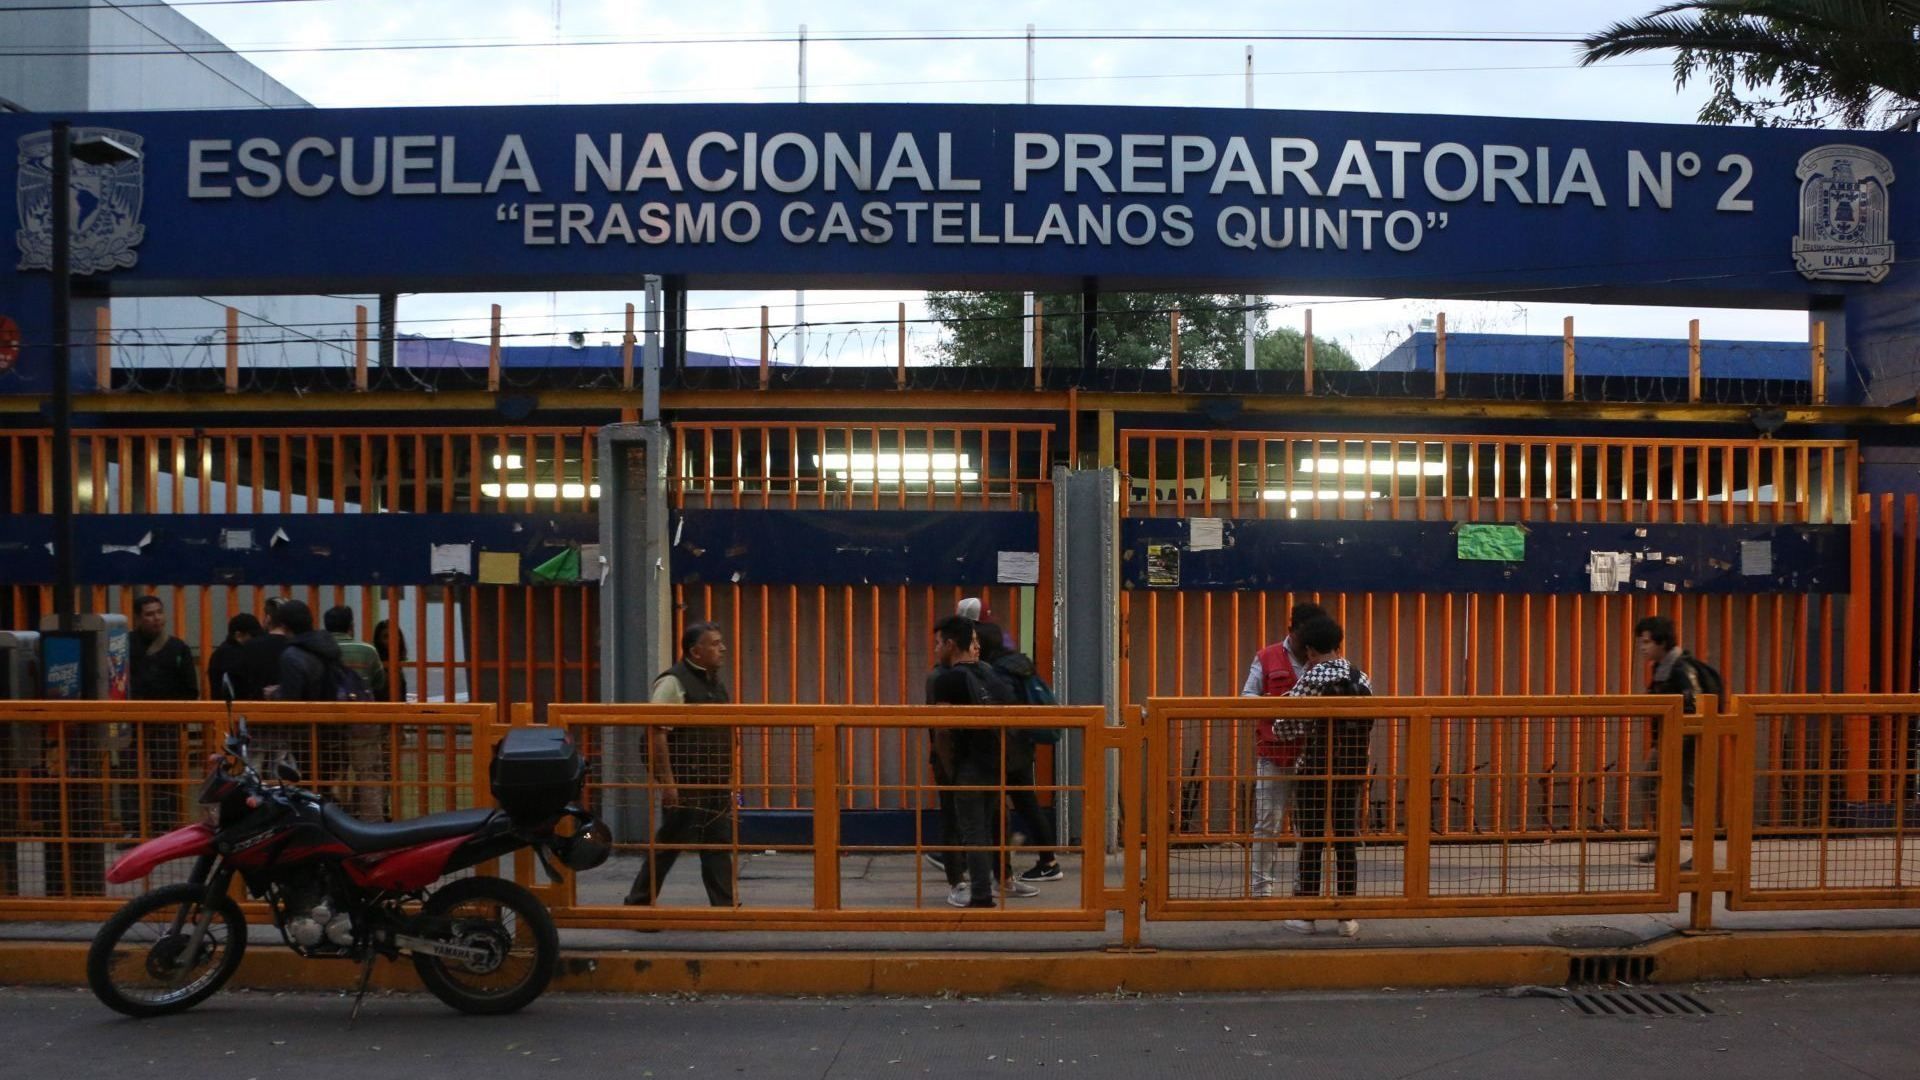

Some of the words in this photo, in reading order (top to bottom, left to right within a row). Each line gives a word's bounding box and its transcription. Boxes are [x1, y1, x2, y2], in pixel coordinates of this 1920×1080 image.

[187, 134, 541, 198] ESCUELA
[574, 131, 982, 193] NACIONAL
[1013, 132, 1607, 208] PREPARATORIA
[1716, 153, 1755, 212] 2
[496, 202, 762, 245] “ERASMO
[779, 201, 1195, 247] CASTELLANOS
[1216, 205, 1449, 252] QUINTO”
[433, 945, 470, 959] YAMAHA
